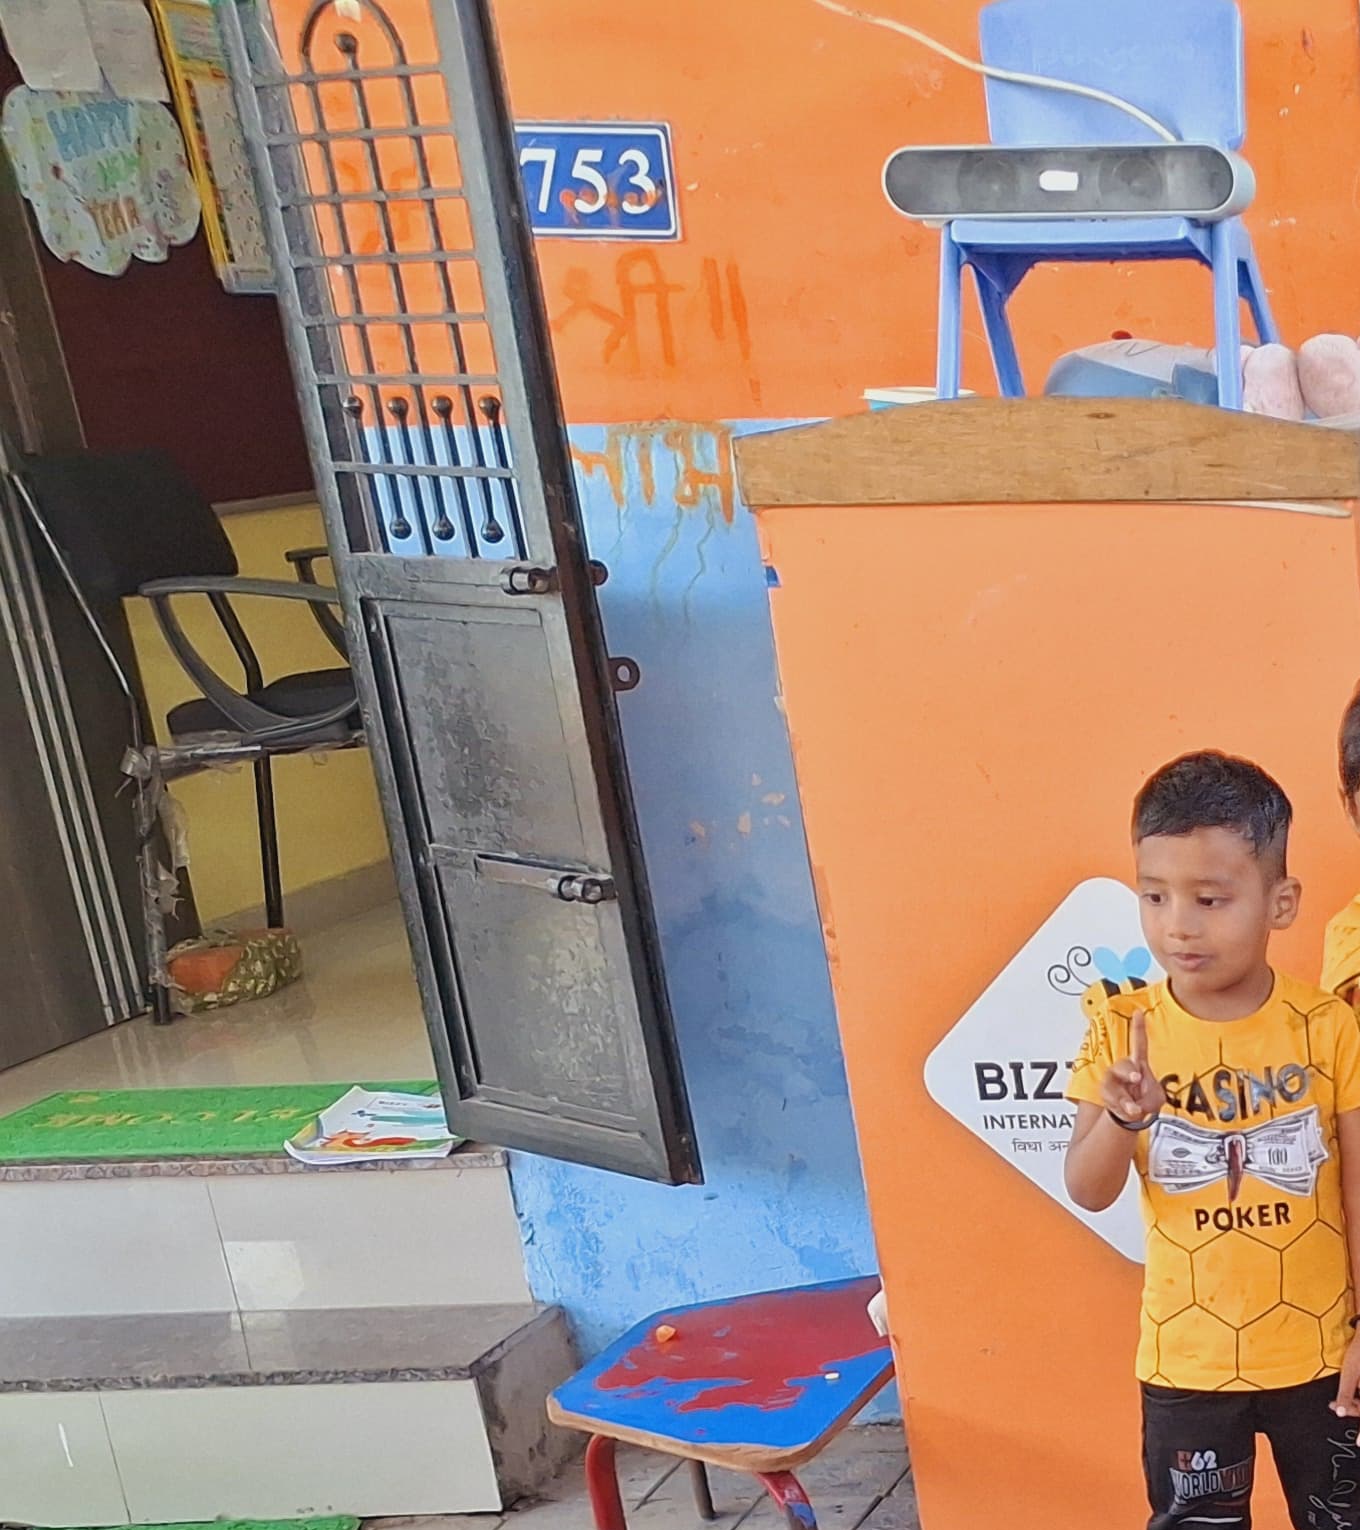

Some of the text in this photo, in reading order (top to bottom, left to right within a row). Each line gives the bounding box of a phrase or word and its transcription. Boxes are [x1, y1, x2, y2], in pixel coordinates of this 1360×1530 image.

[974, 1061, 1074, 1101] BIZ
[1160, 1063, 1310, 1122] CASINO
[1194, 1202, 1292, 1231] POKER
